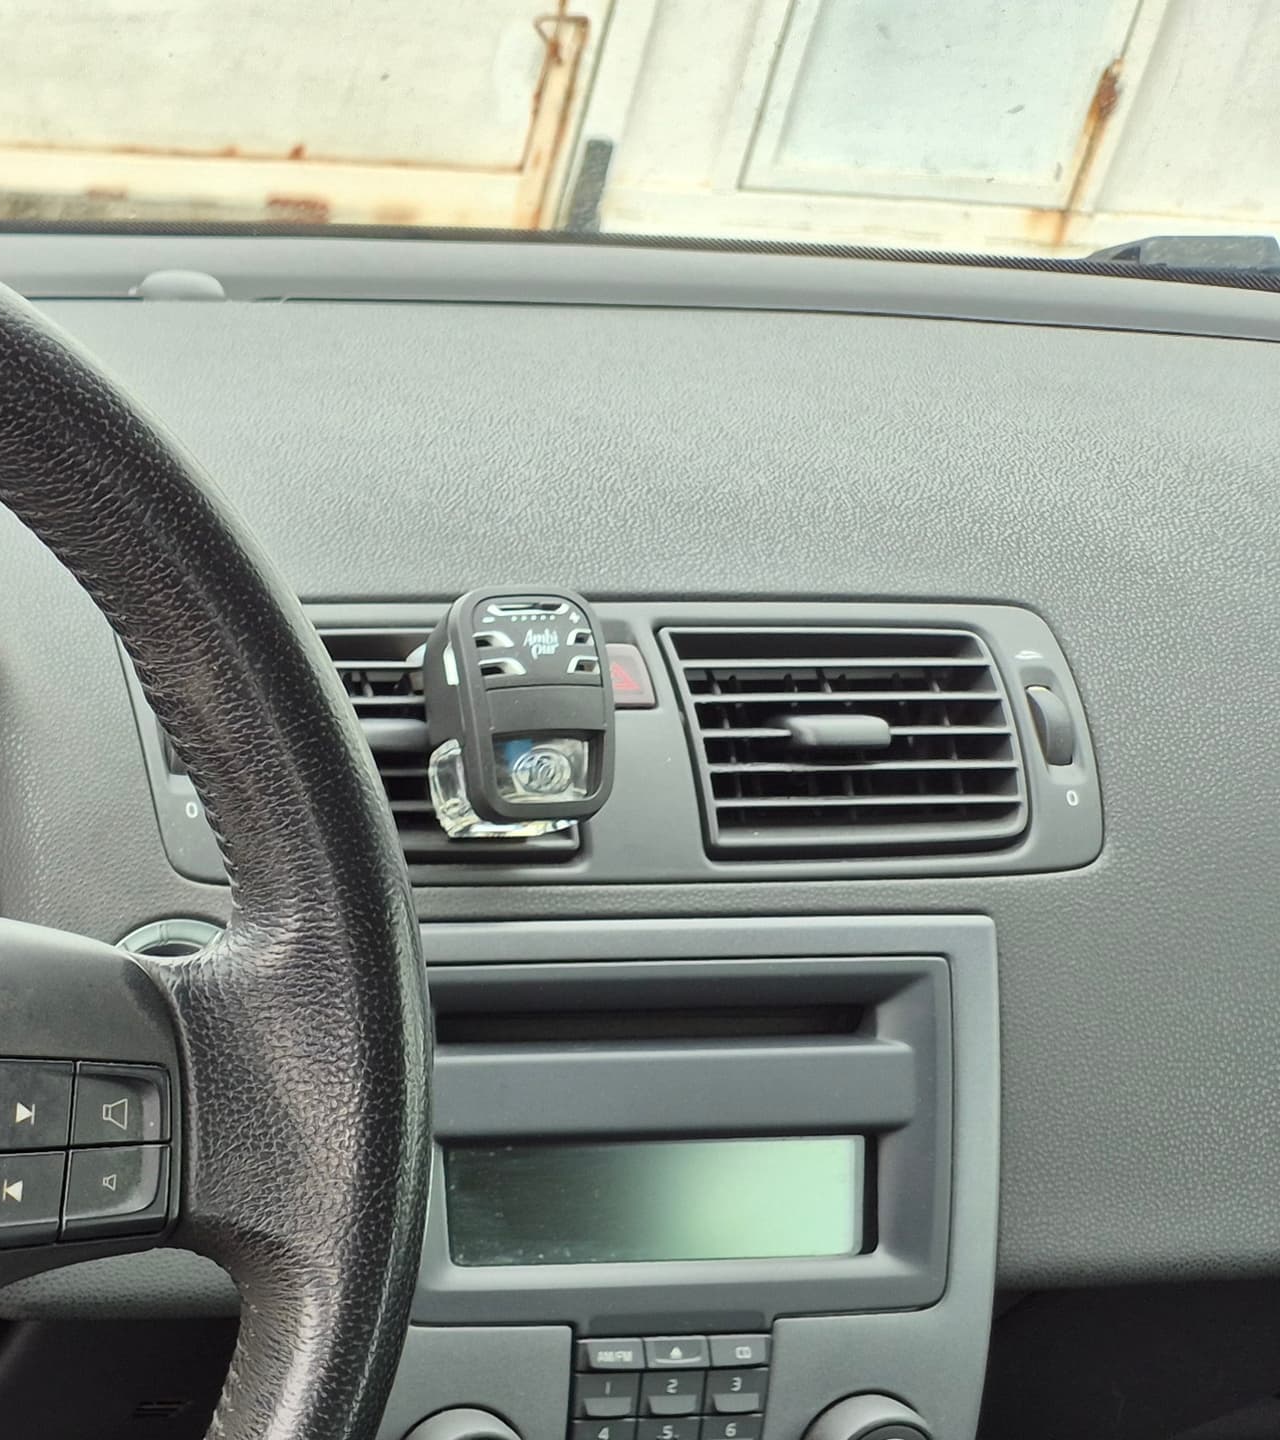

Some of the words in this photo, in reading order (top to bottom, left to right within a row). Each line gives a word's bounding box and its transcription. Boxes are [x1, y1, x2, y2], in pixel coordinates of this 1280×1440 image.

[666, 1379, 679, 1393] 2
[730, 1377, 743, 1391] 3
[598, 1427, 610, 1440] 4
[662, 1425, 673, 1440] 5
[725, 1423, 737, 1437] 6
